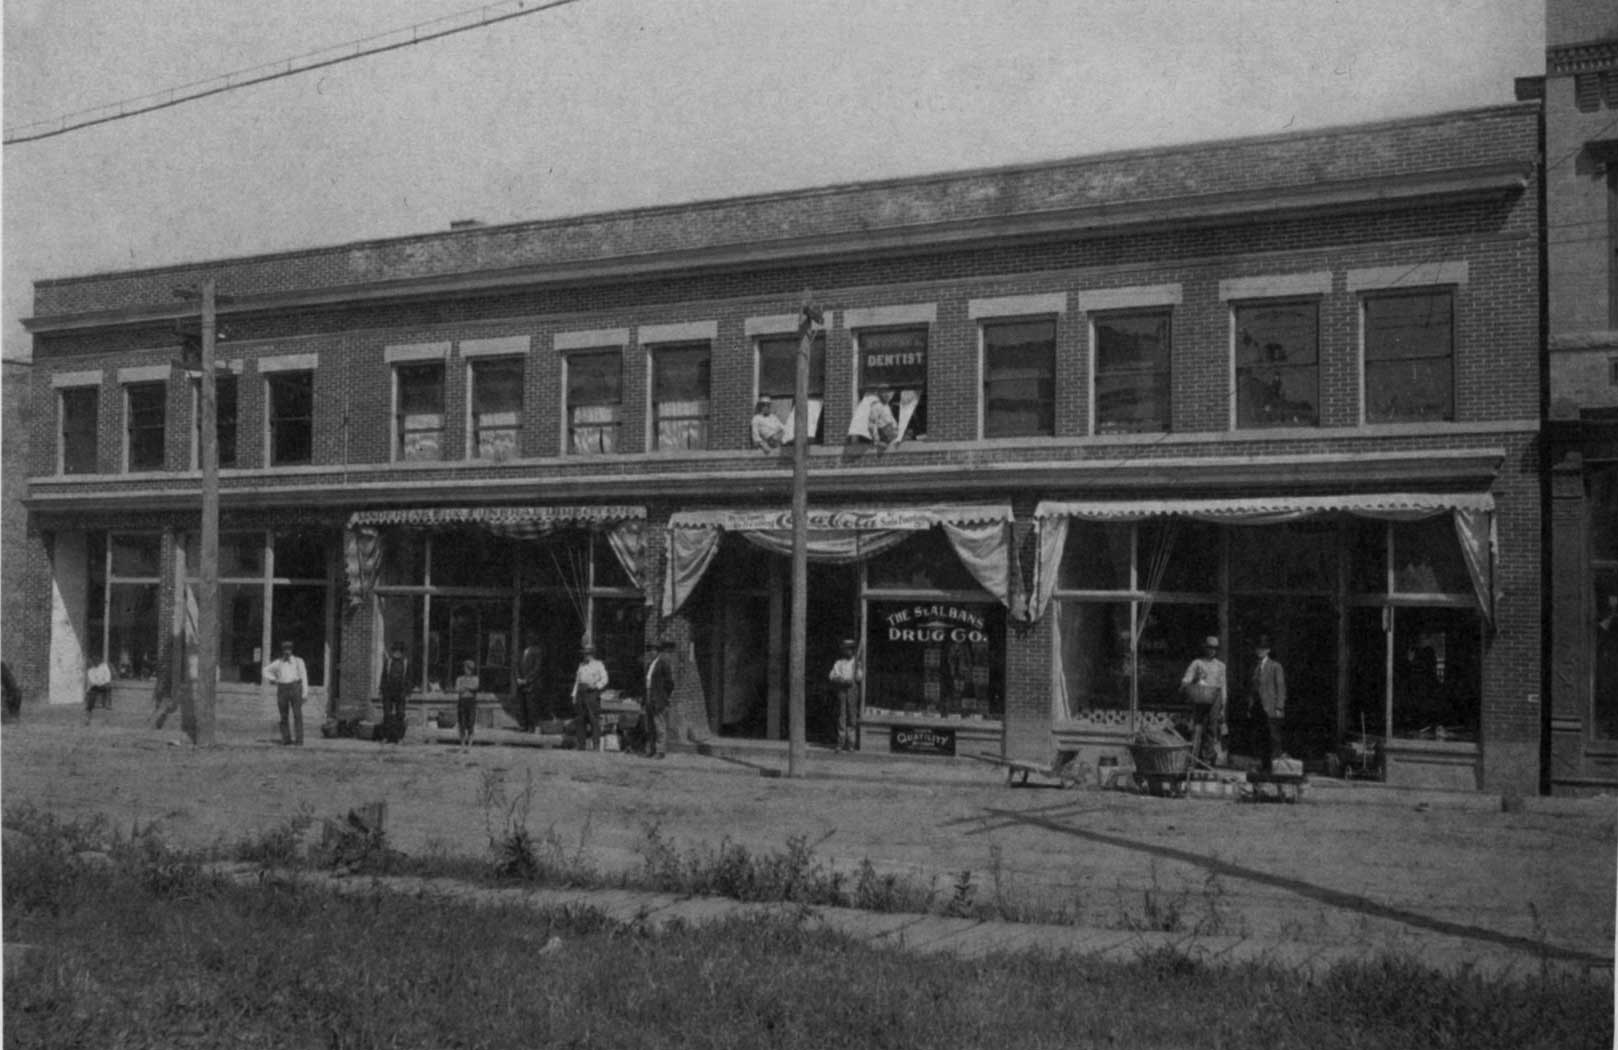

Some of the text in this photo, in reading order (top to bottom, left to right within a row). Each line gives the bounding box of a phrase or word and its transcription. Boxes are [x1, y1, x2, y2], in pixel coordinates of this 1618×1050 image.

[868, 352, 924, 367] DENTIST
[887, 609, 911, 626] THE
[888, 627, 945, 642] DRUG
